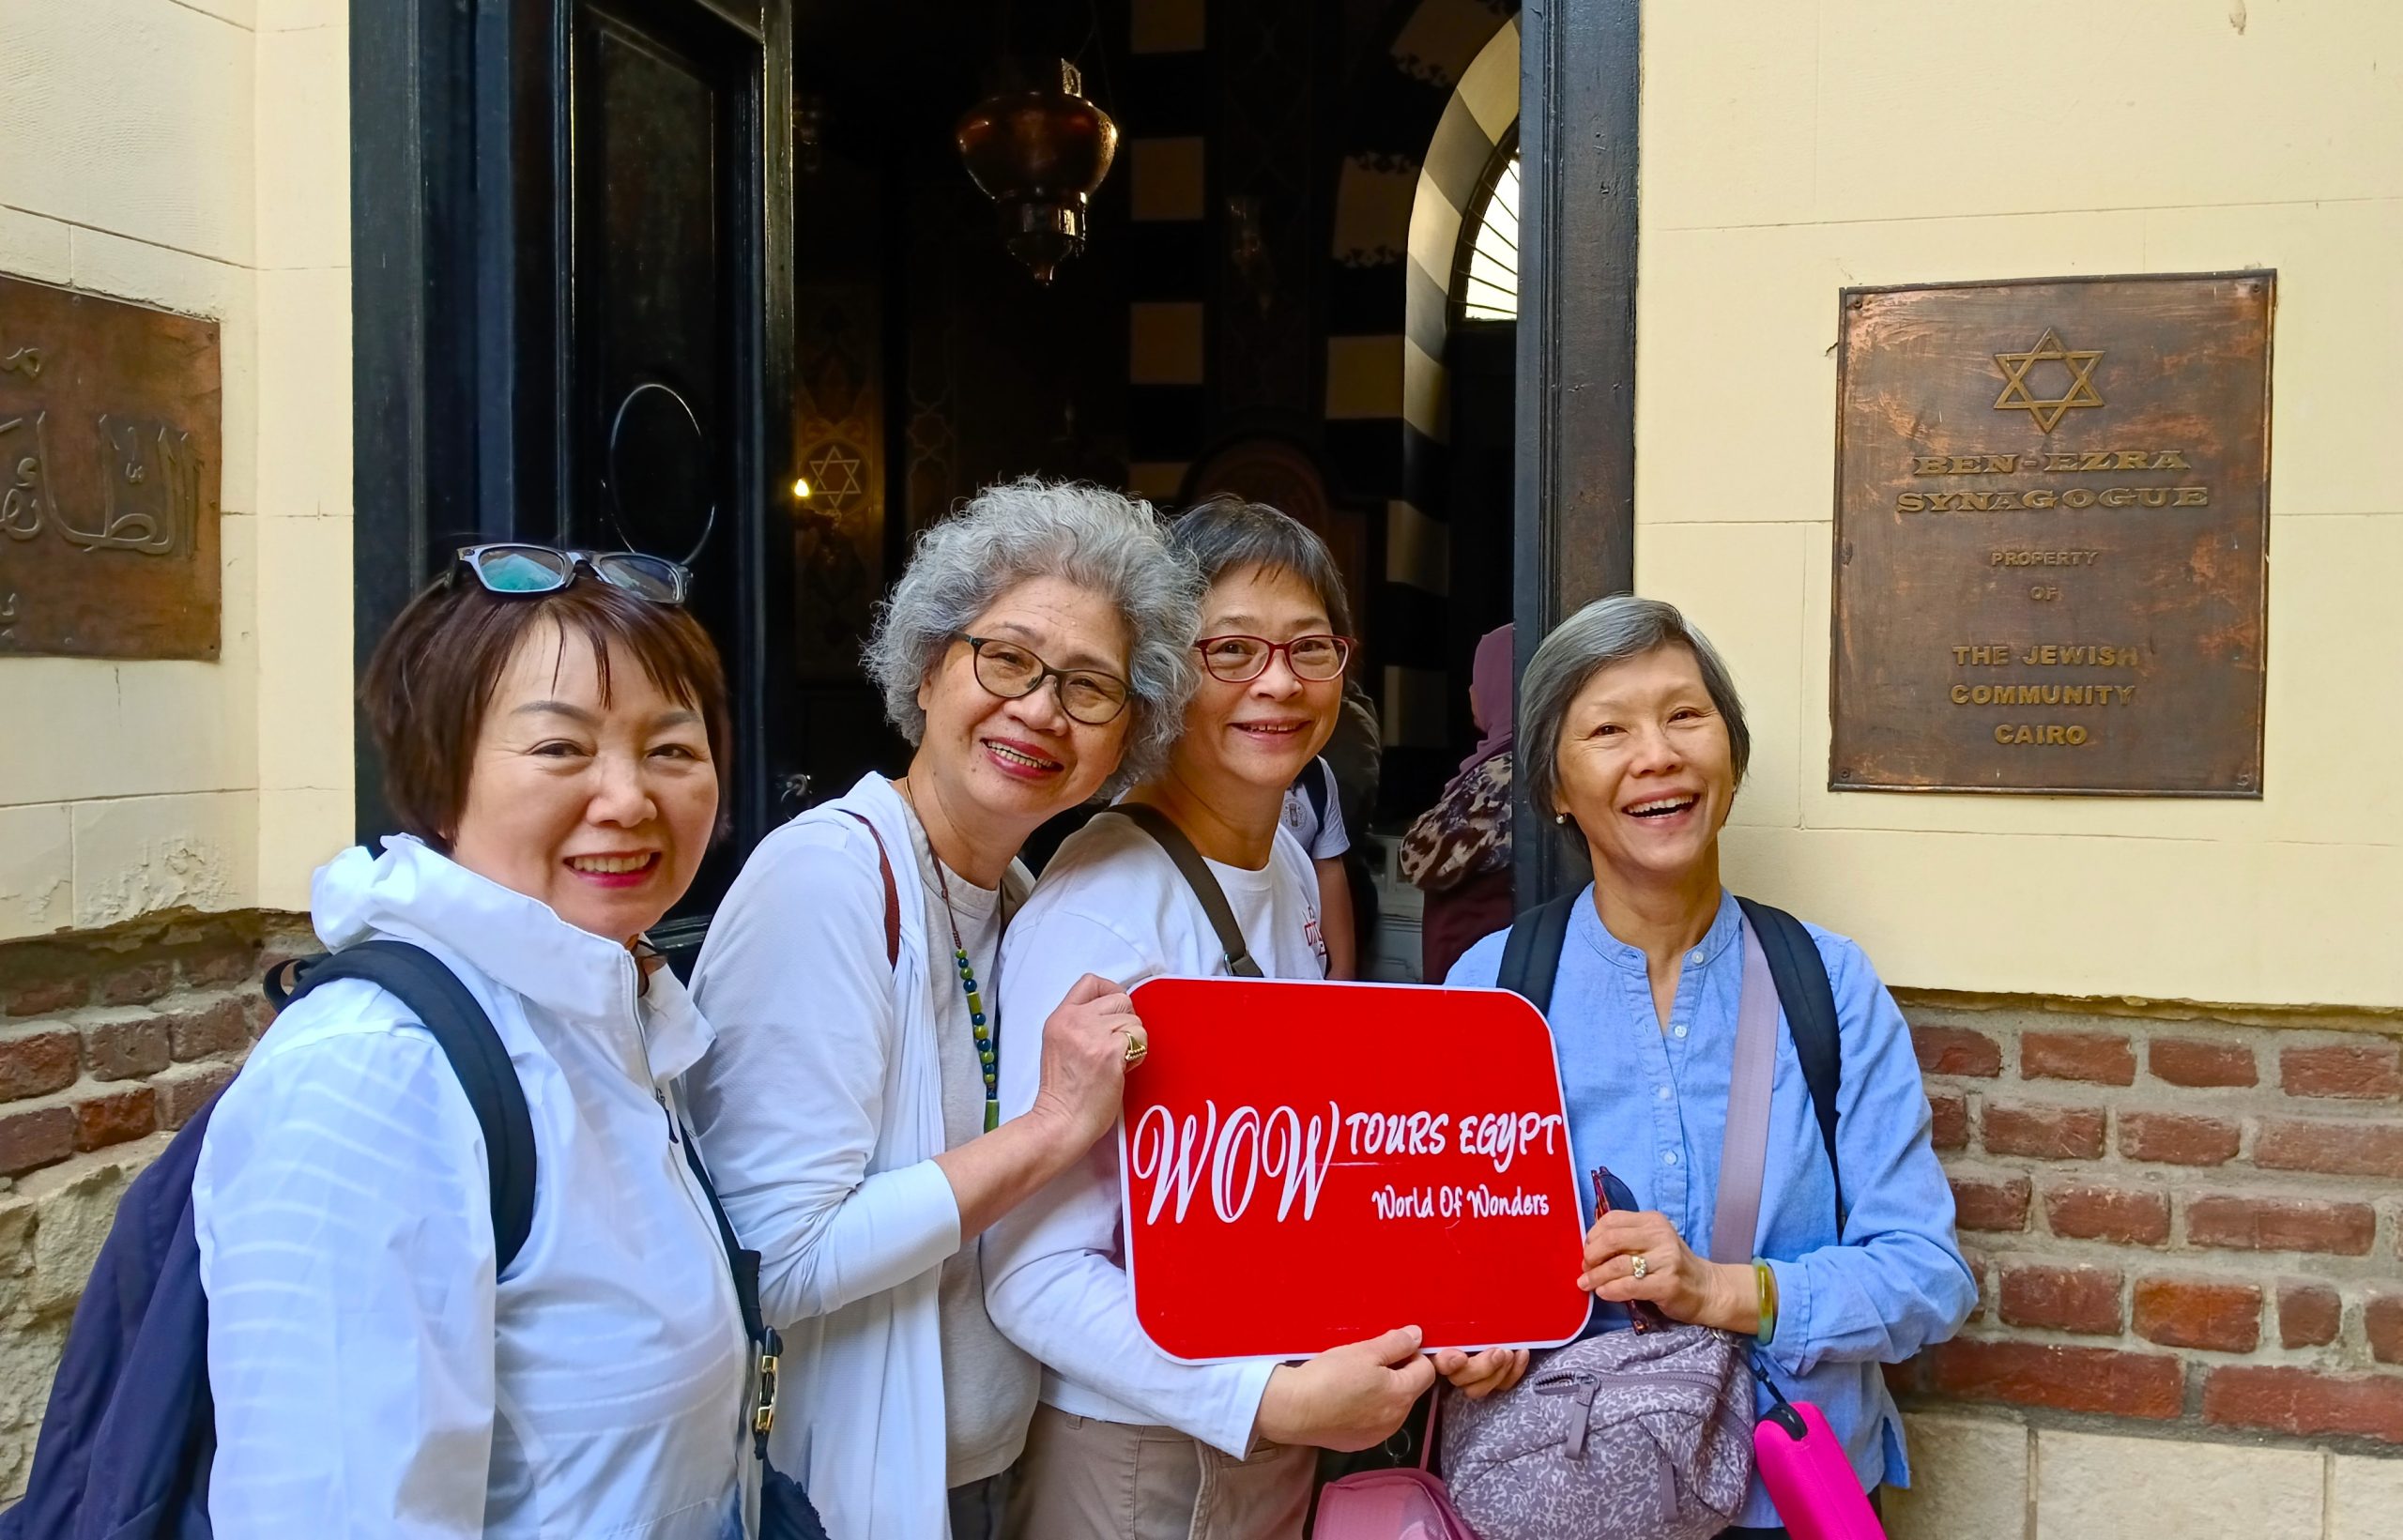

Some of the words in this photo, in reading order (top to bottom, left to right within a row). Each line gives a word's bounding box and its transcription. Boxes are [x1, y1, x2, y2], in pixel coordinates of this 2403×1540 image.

[1895, 486, 2209, 513] SYNAGOGUE
[1991, 551, 2099, 568] PROPERTY
[2030, 587, 2059, 602] OF
[1951, 645, 2010, 666] THE
[2022, 645, 2138, 666] JEWISH
[1950, 683, 2136, 706] COMMUNITY
[1994, 724, 2089, 746] CAIRO
[1132, 1099, 1340, 1226] WOW
[1344, 1111, 1449, 1155] TOURS
[1459, 1111, 1563, 1173] EGYPT
[1371, 1183, 1434, 1220] World
[1439, 1185, 1463, 1218] Of
[1466, 1183, 1551, 1219] Wonders
